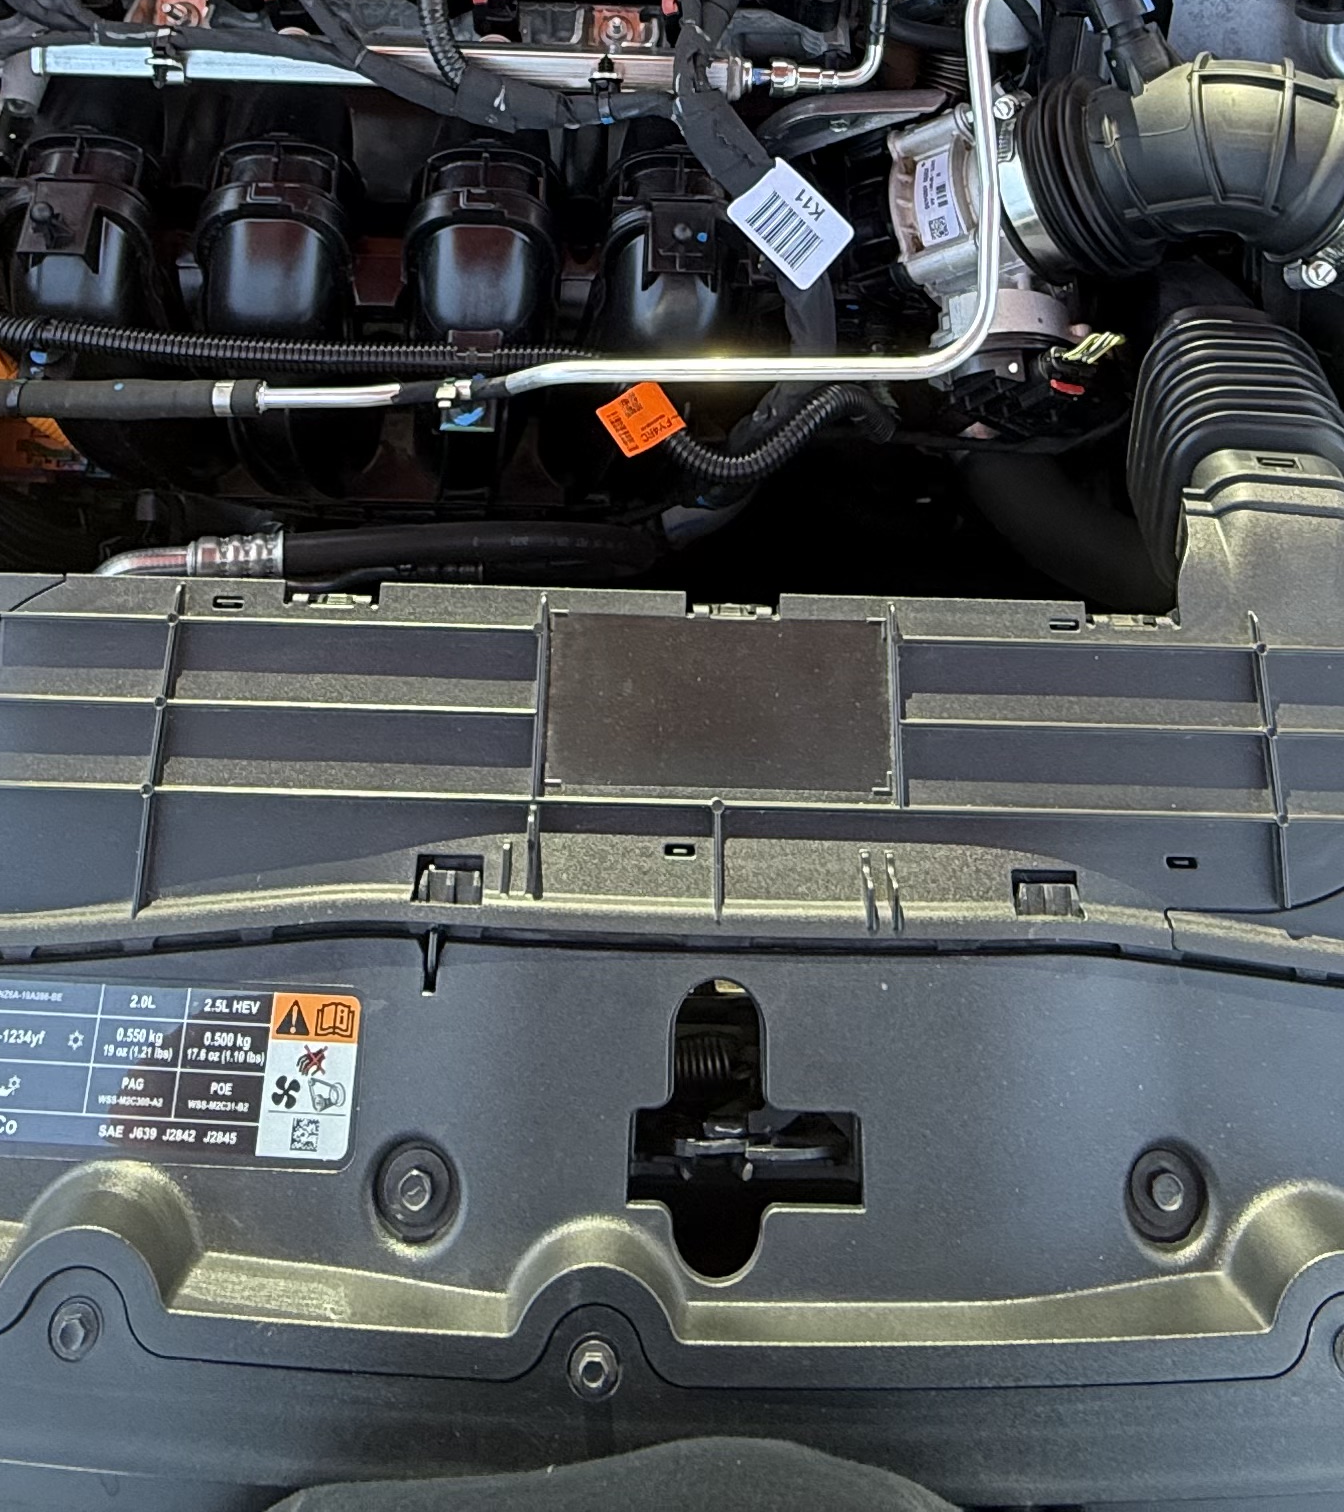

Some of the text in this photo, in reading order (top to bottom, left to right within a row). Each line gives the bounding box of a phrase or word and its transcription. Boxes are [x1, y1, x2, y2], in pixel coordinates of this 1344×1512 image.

[795, 188, 826, 222] K11
[130, 996, 156, 1010] 2.0L
[204, 999, 261, 1015] 2.5L HEV
[116, 1029, 163, 1047] 0.550 kg
[203, 1032, 252, 1050] 0.500 kg
[103, 1044, 172, 1062] 19 oz (1.21 lbs)
[187, 1049, 265, 1066] 17.6 oz (1.10 lbs)
[121, 1077, 144, 1091] PAG
[210, 1081, 233, 1096] POE
[98, 1124, 237, 1145] SAE J639 J2842 J2845
